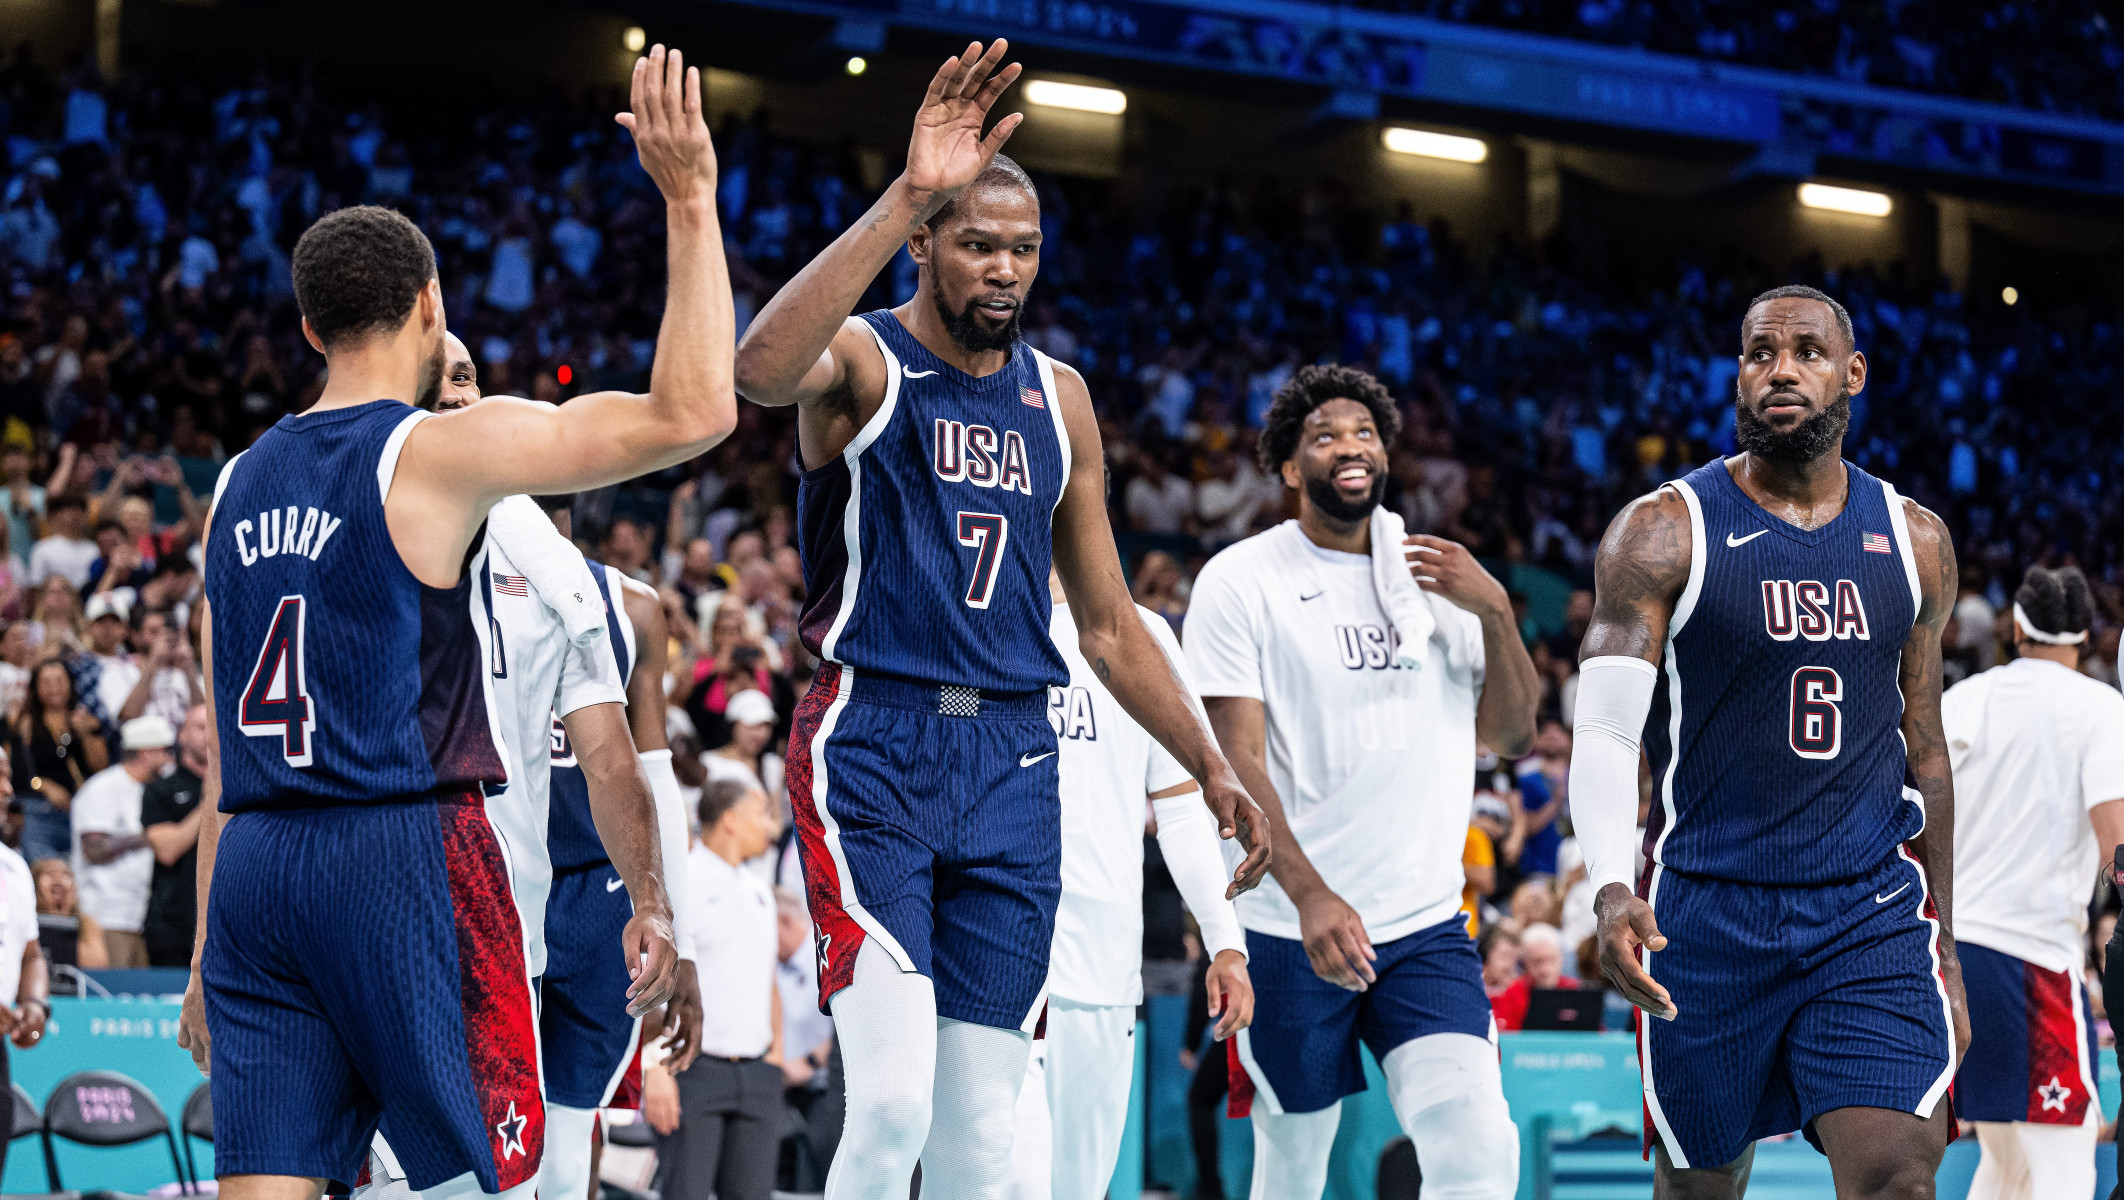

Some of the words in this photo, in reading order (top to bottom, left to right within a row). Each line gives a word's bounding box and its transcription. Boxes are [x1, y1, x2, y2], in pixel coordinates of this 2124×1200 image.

[934, 418, 1032, 496] USA
[234, 505, 342, 568] CURRY
[956, 511, 1008, 610] 7
[1761, 579, 1871, 642] USA
[237, 593, 317, 769] 4
[1788, 665, 1844, 761] 6
